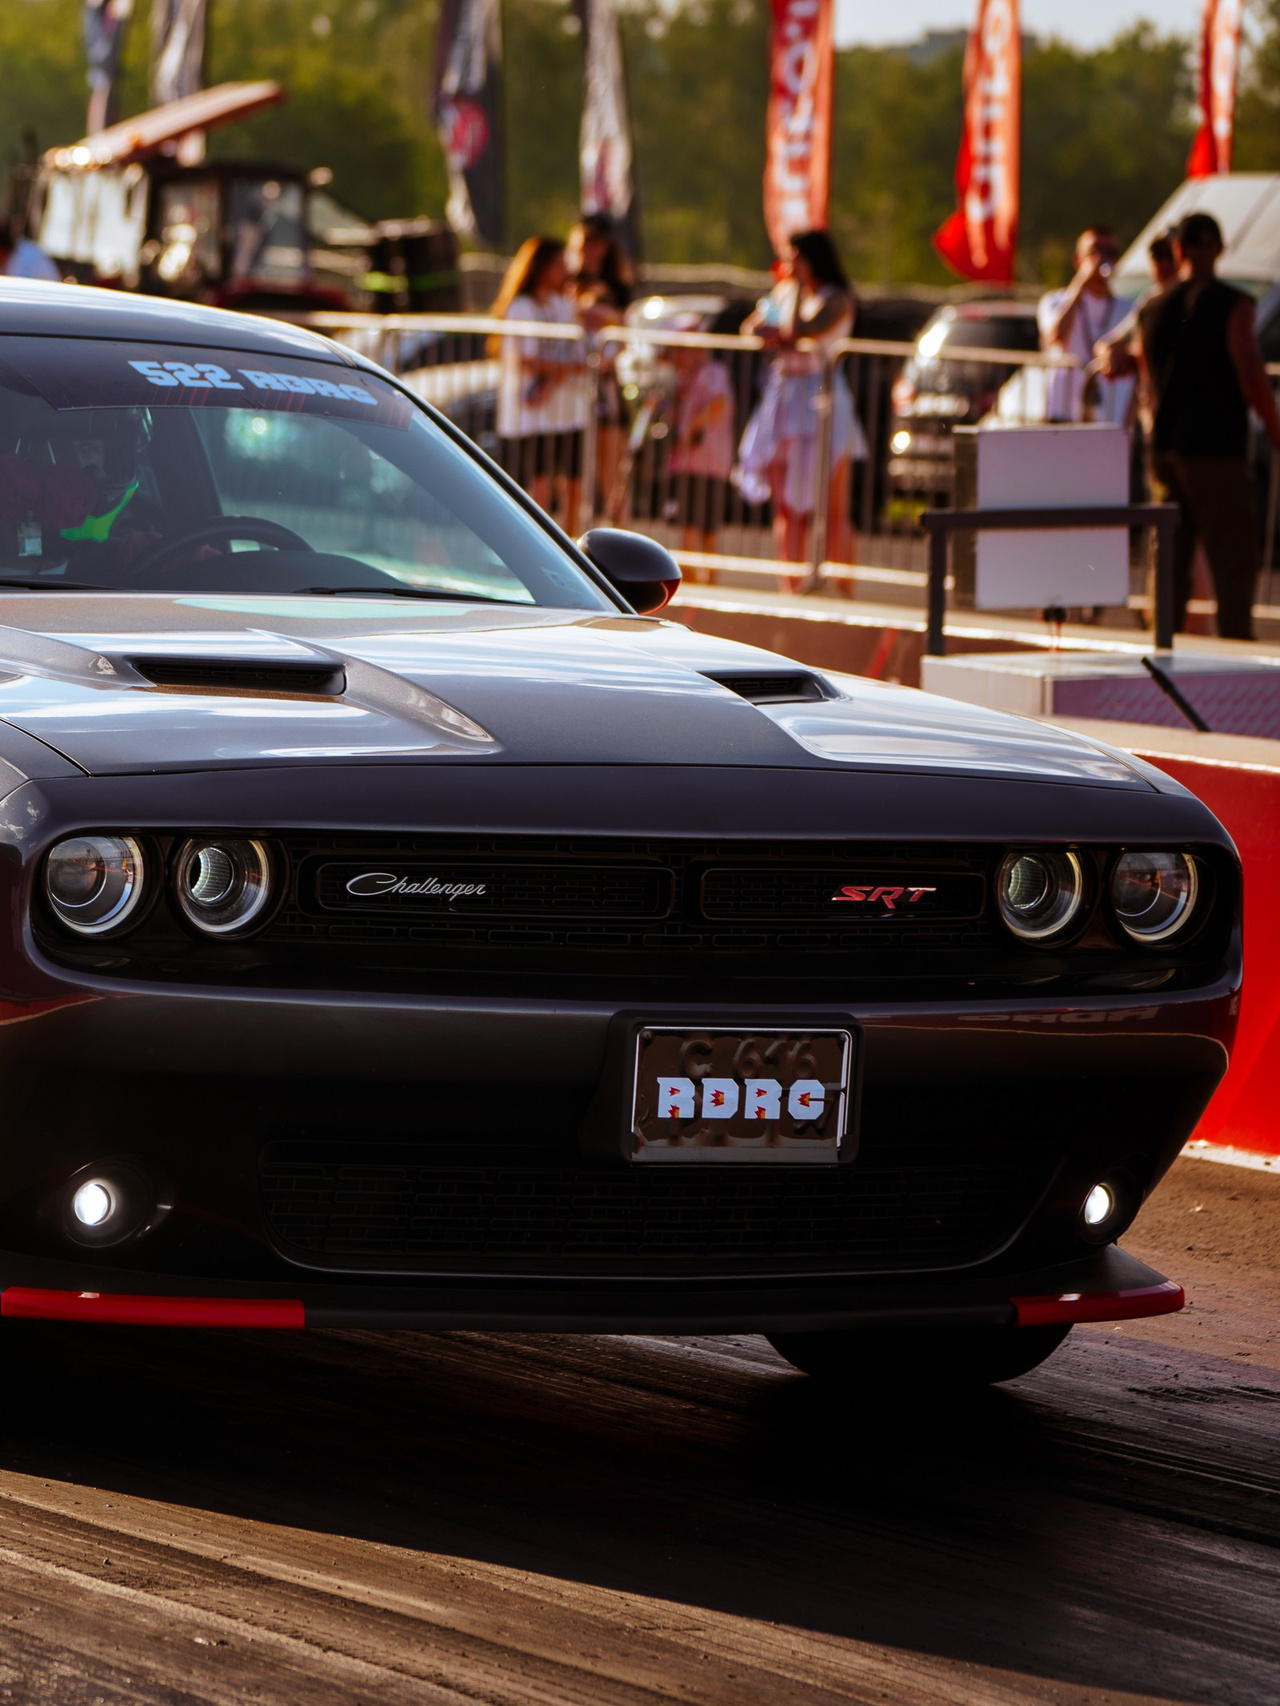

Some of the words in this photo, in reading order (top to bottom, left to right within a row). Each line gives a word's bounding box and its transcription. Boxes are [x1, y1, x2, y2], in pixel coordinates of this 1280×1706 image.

[127, 360, 245, 390] 522
[237, 369, 379, 406] RDRC
[346, 872, 486, 902] Challenger
[831, 885, 937, 909] SRT
[656, 1077, 826, 1121] RDRC
